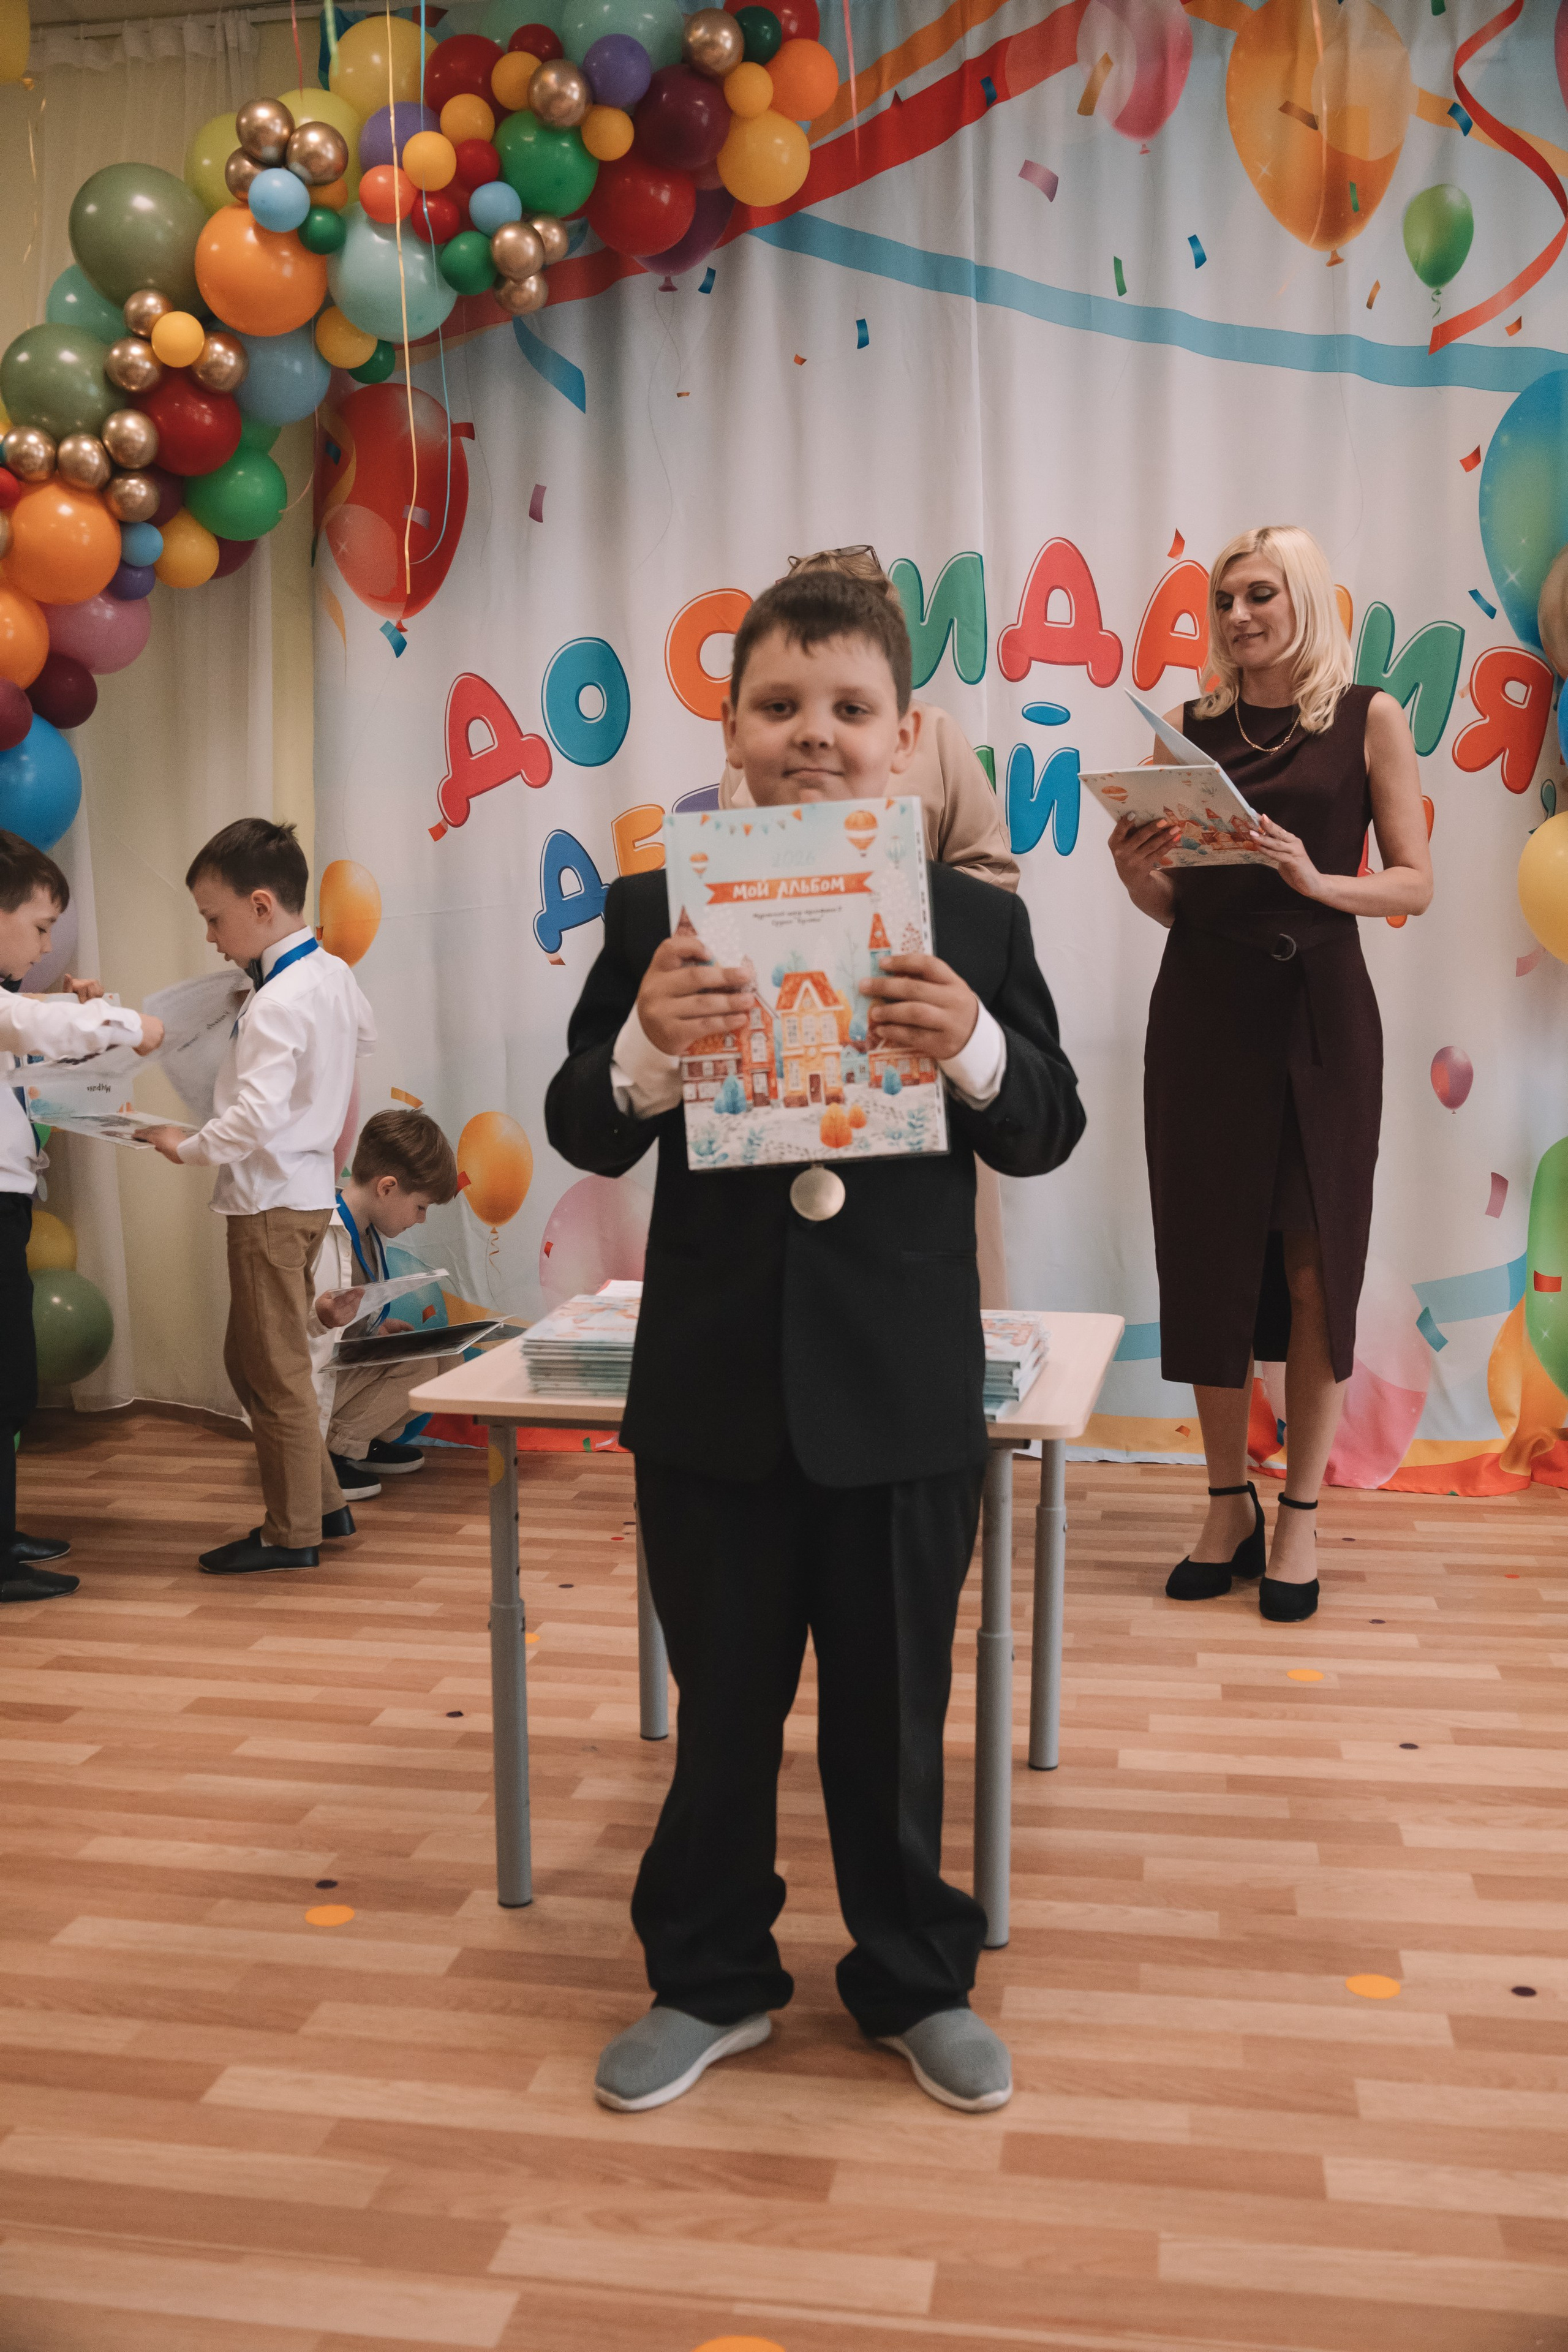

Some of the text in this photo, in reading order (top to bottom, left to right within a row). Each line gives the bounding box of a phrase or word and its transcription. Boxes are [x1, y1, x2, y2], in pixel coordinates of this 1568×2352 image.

[437, 636, 630, 828] ДО
[665, 537, 1554, 795] СИДАИЯ
[733, 876, 846, 900] МОЙ АЛЬБОМ
